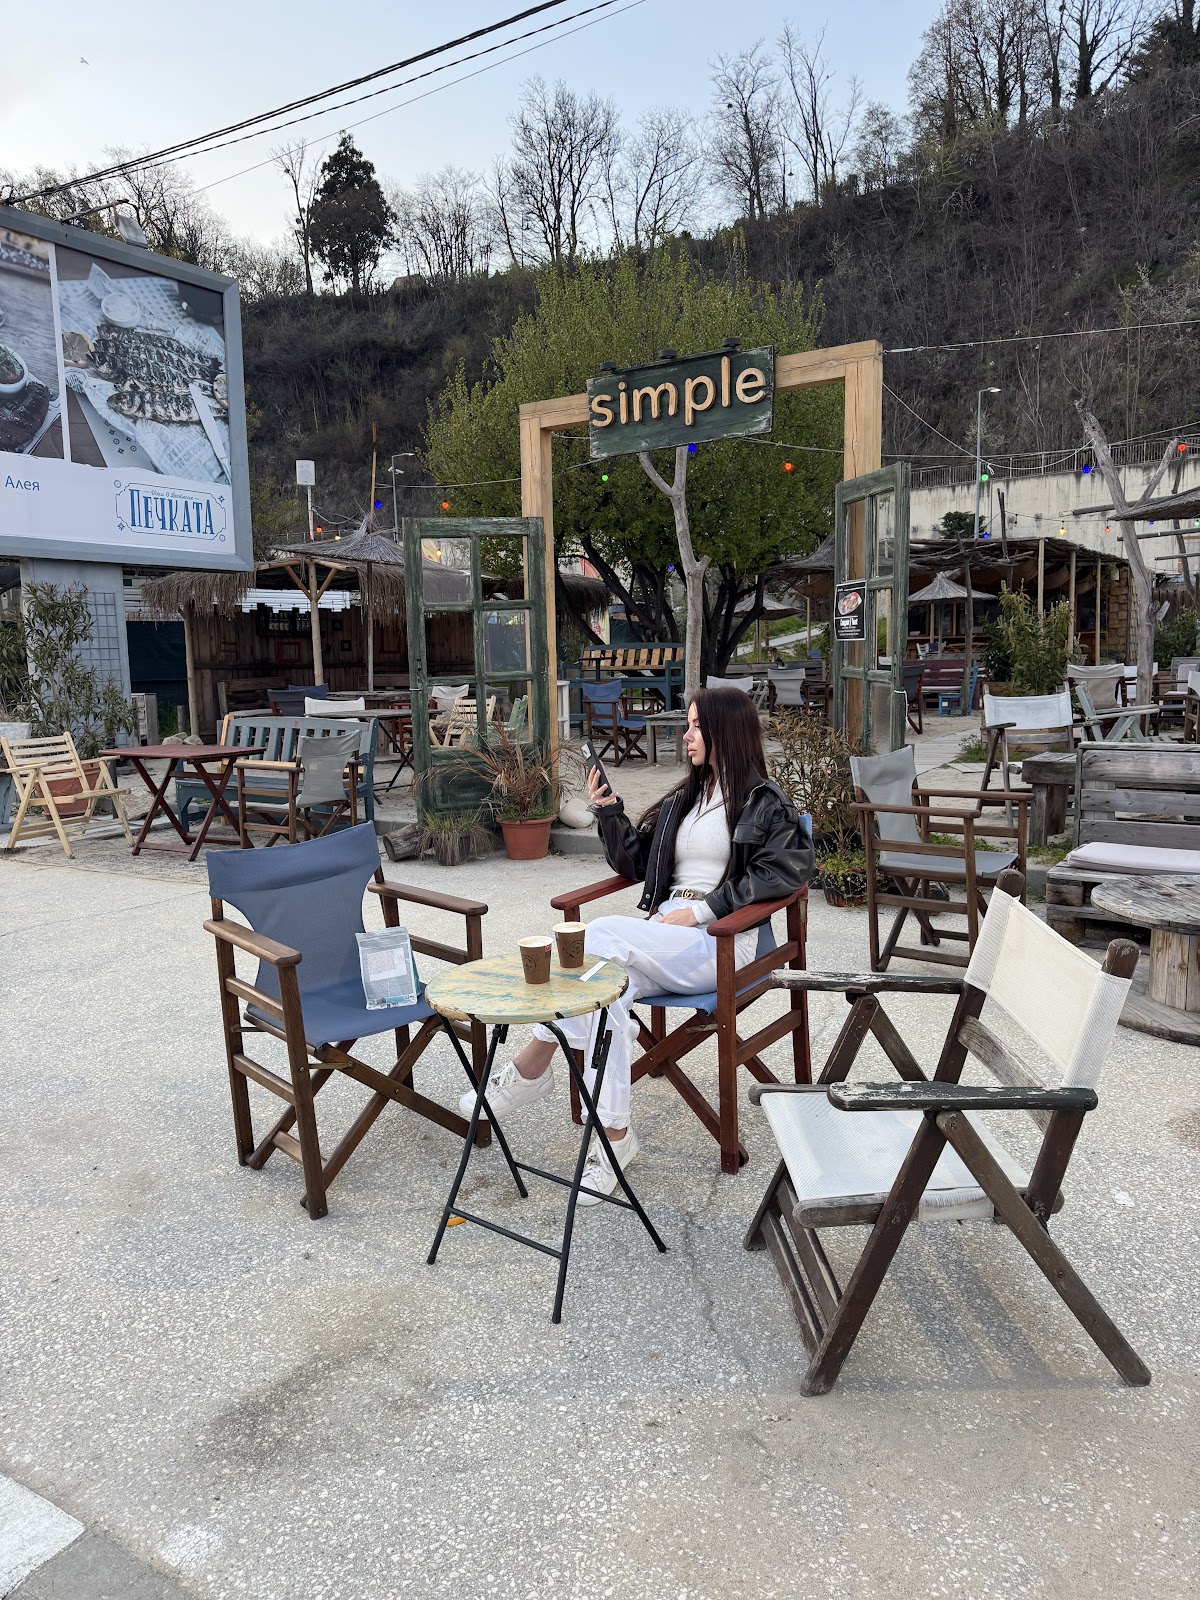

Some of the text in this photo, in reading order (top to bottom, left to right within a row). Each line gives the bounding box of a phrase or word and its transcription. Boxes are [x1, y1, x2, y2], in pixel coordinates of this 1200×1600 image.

[591, 356, 766, 427] simple
[5, 475, 40, 491] Алея
[128, 488, 215, 535] ПЕЧКАТА
